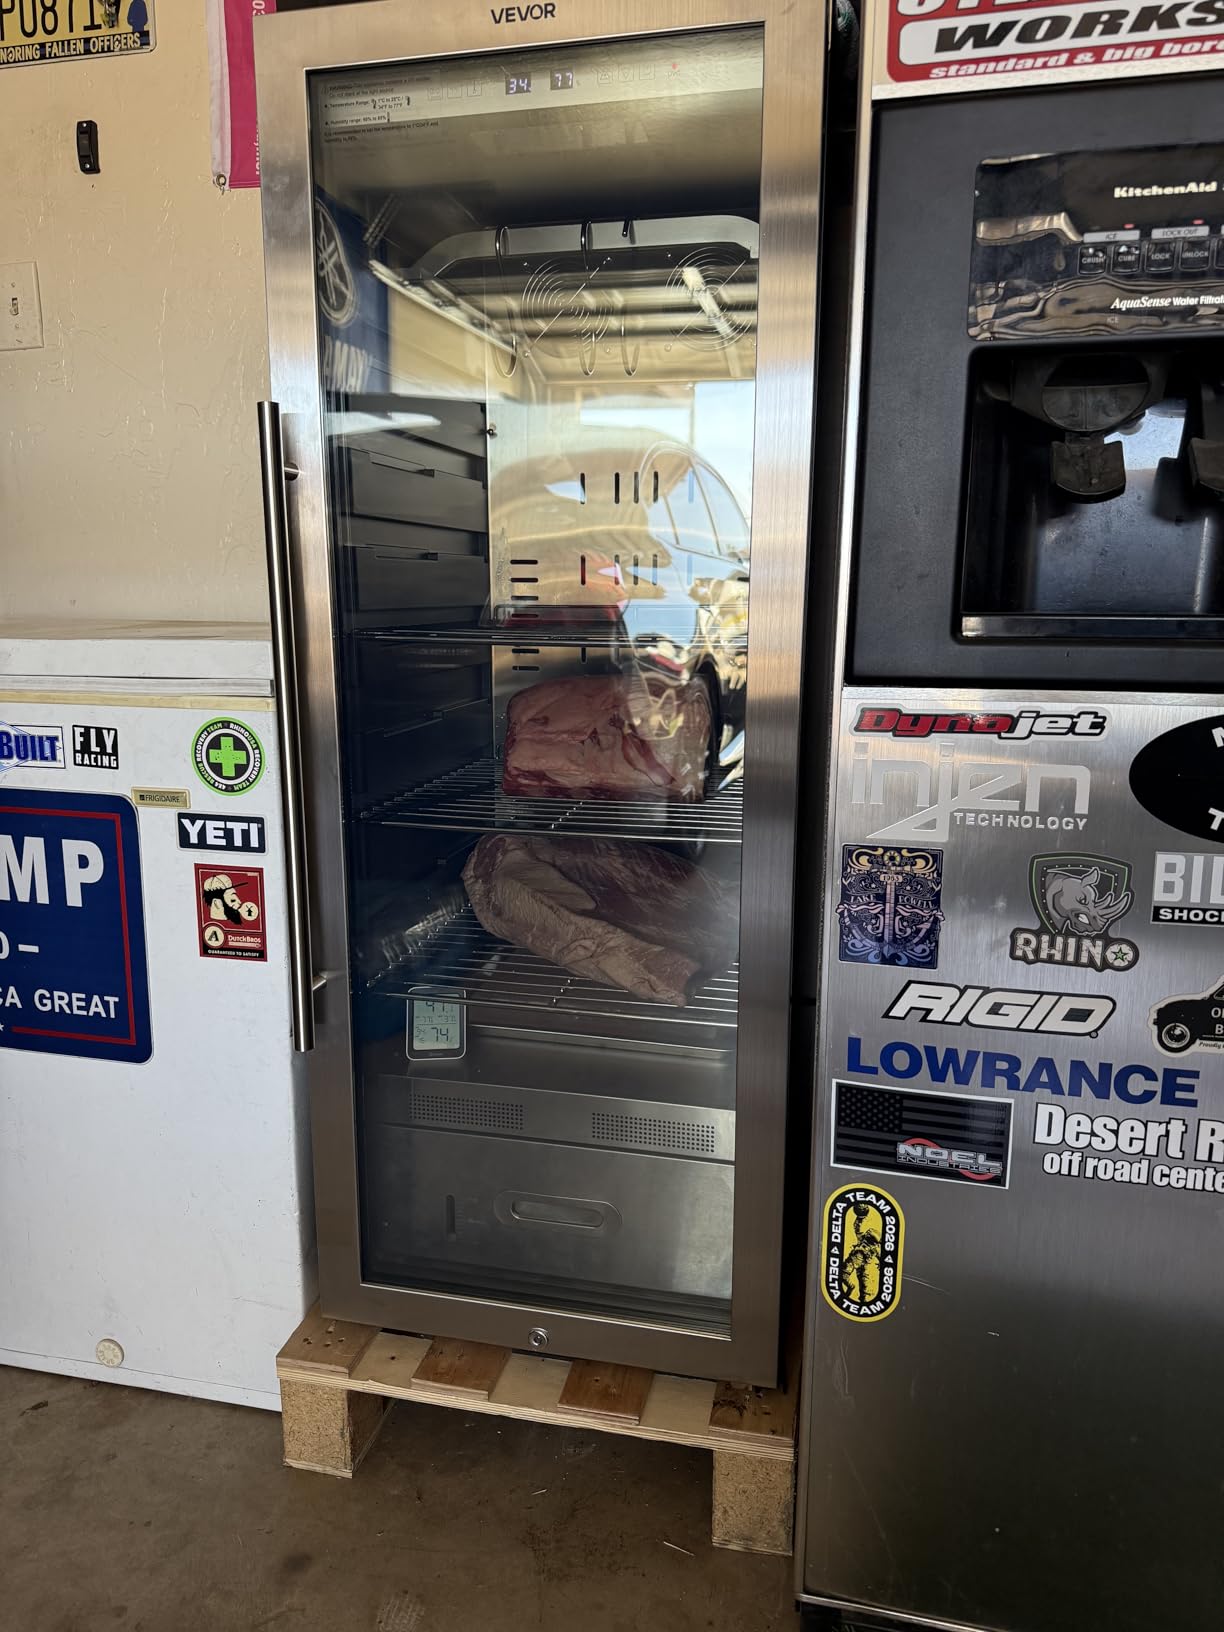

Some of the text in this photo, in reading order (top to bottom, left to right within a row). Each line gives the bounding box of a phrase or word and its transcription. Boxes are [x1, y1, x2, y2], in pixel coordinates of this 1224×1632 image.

[491, 3, 556, 25] VEVOR
[46, 39, 84, 58] FALLEN
[90, 32, 141, 53] OFFICERS
[929, 52, 1069, 78] standard
[1073, 52, 1096, 65] &
[1102, 44, 1154, 62] big
[555, 72, 573, 88] 77
[1113, 181, 1217, 198] KitchenAid
[1151, 252, 1170, 260] LOCK
[1110, 296, 1172, 311] AquaSense
[1173, 297, 1198, 306] Water
[855, 708, 1106, 738] Dynajet
[74, 727, 115, 753] FLY
[75, 753, 117, 767] RACING
[145, 794, 180, 803] FRIGIDAIRE
[180, 818, 260, 848] YETI
[953, 812, 1088, 830] TECHNOLOGY
[850, 894, 876, 903] LAKE
[1159, 908, 1224, 922] SHOC
[34, 988, 119, 1019] GREAT
[886, 981, 1114, 1036] RIGID
[846, 1037, 1200, 1107] LOWRANCE
[1033, 1101, 1187, 1159] Desert
[898, 1143, 1002, 1166] NOEL
[898, 1156, 1002, 1175] INDUSTRIES
[1043, 1150, 1083, 1177] off
[1084, 1157, 1151, 1185] road
[831, 1191, 896, 1252] DELTA TEAM 2026
[828, 1258, 894, 1315] DELTA TEAM 2026
